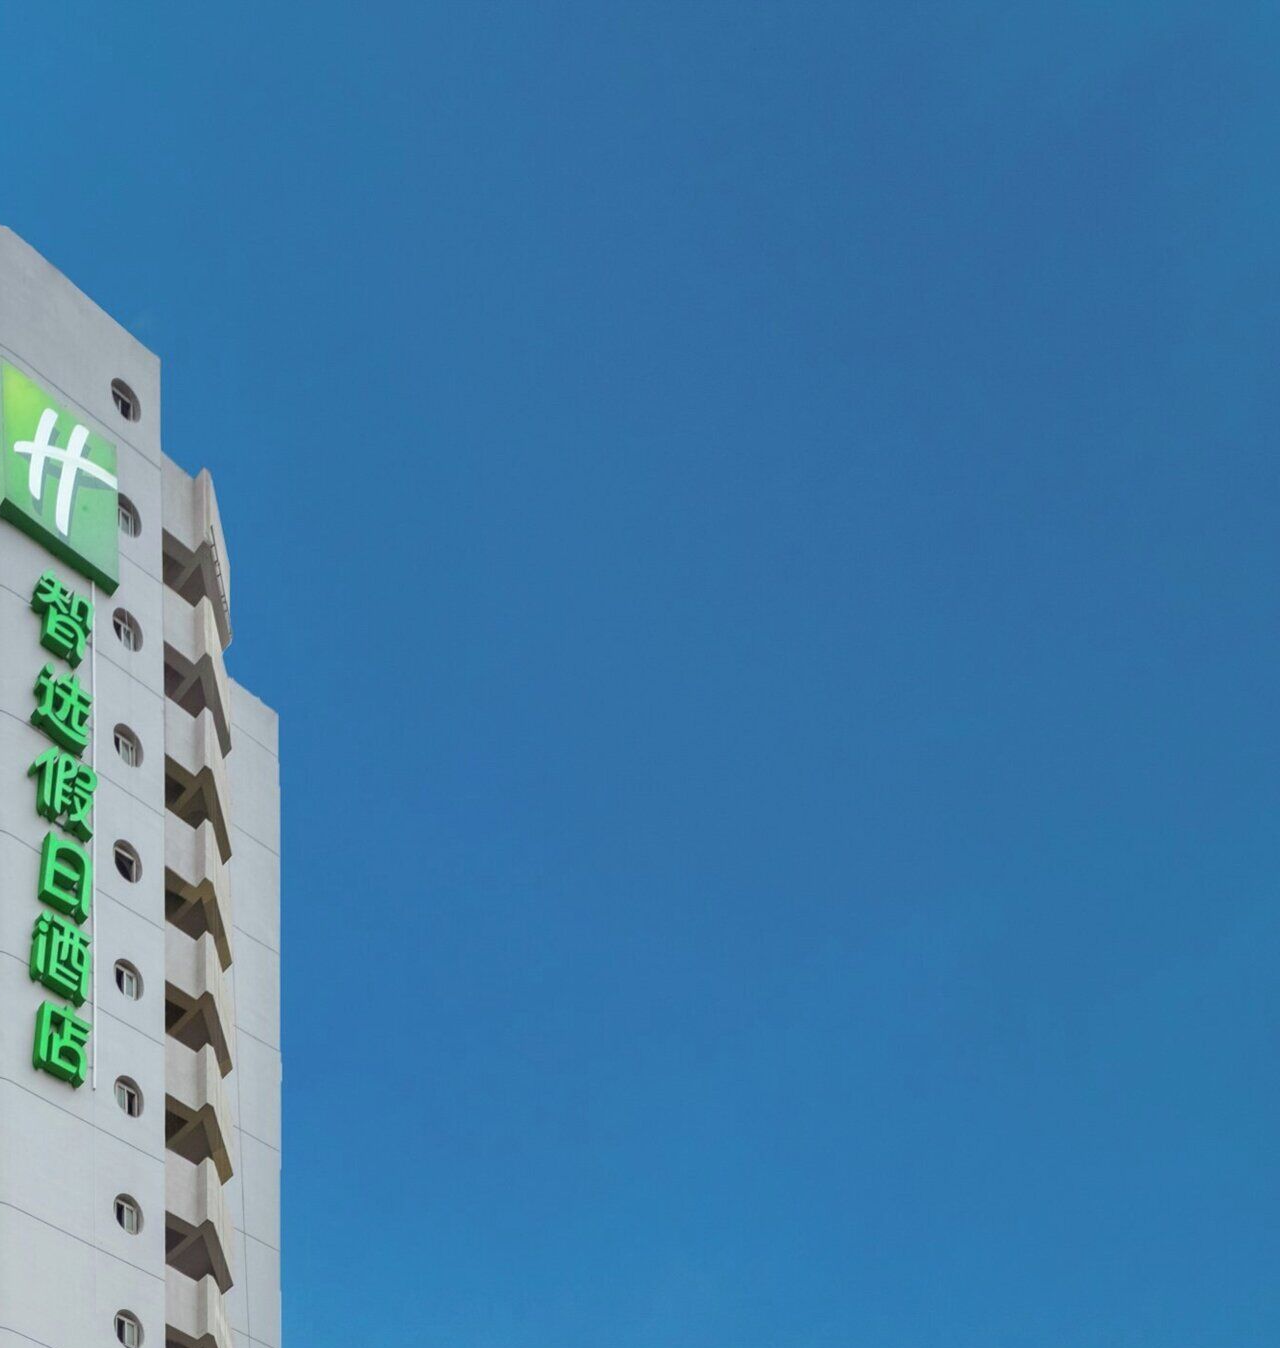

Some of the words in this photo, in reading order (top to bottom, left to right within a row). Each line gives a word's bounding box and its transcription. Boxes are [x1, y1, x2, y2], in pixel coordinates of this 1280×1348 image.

[28, 568, 97, 1090] 智选假日酒店
